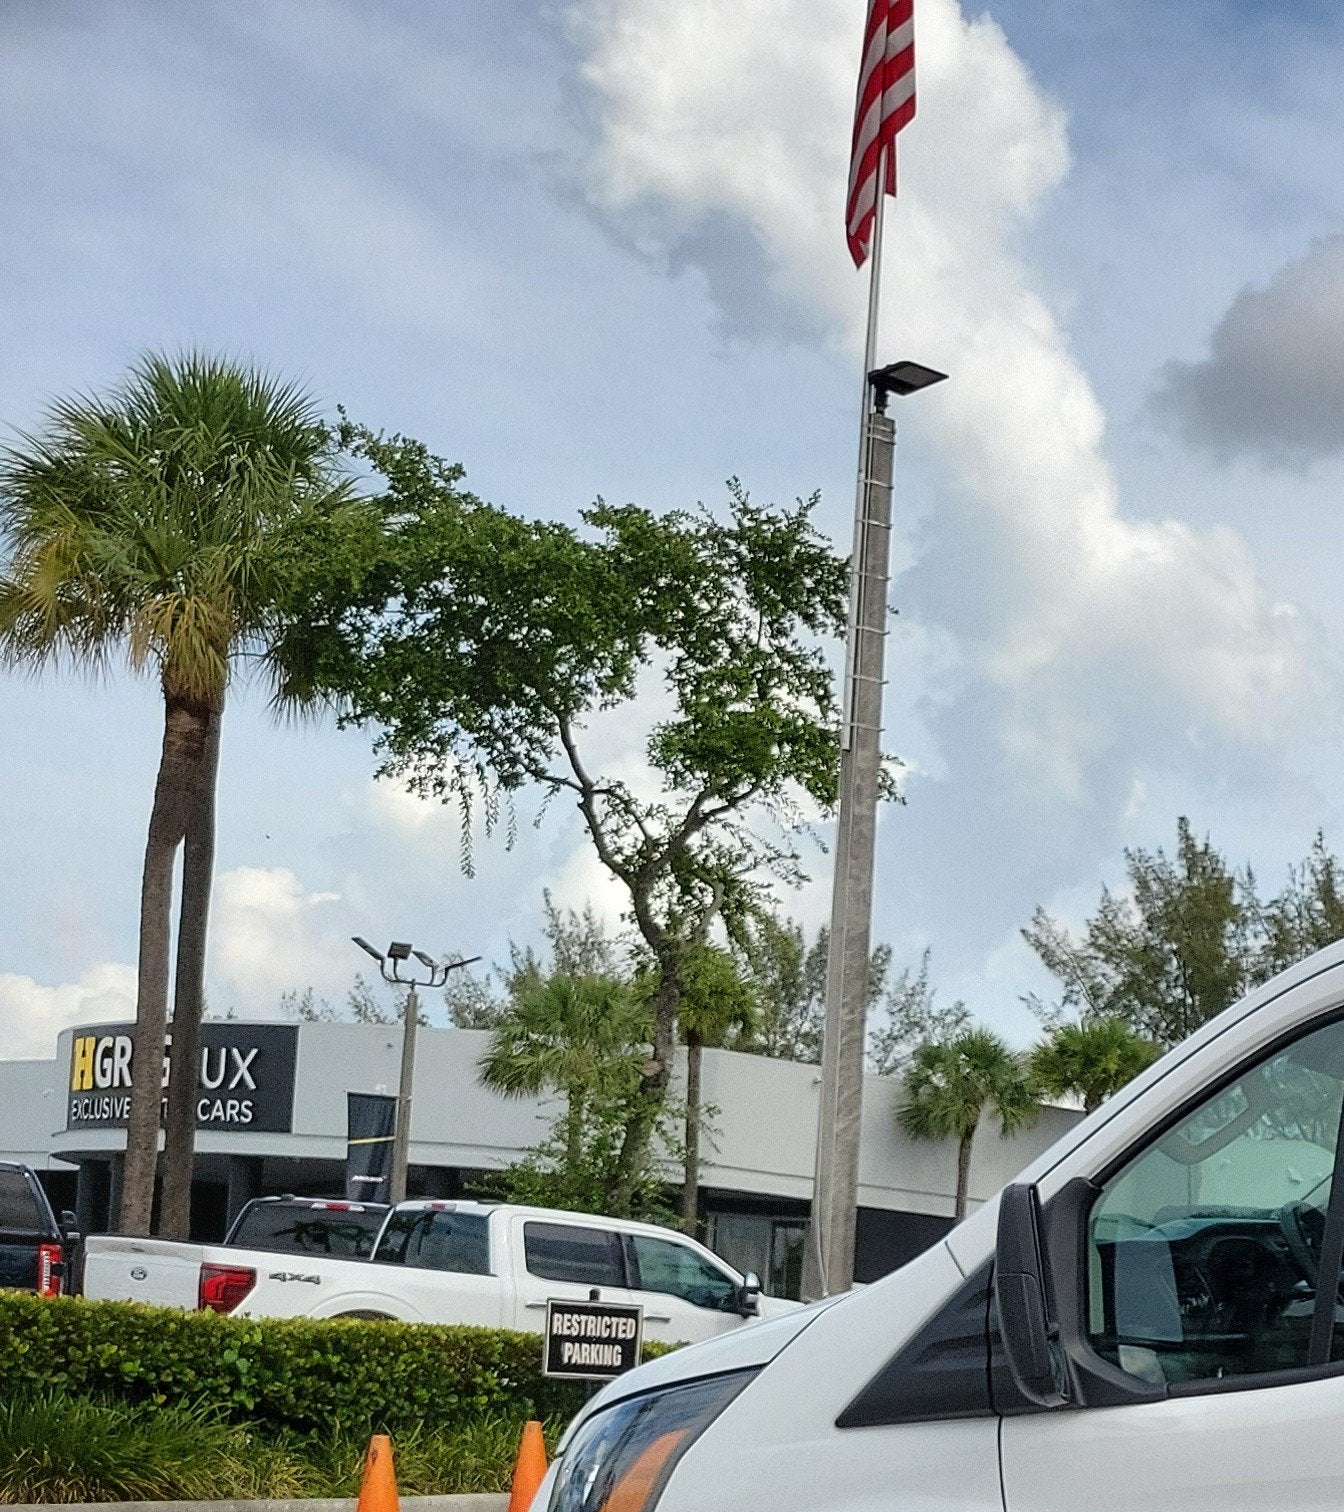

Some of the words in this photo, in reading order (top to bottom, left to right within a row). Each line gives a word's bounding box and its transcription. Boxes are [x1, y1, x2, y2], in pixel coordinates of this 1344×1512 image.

[201, 1047, 259, 1089] UX
[72, 1097, 131, 1120] EXCLUSIVE
[196, 1098, 253, 1123] CARS
[552, 1313, 637, 1339] RESTRICTED
[562, 1342, 622, 1366] PARKING
